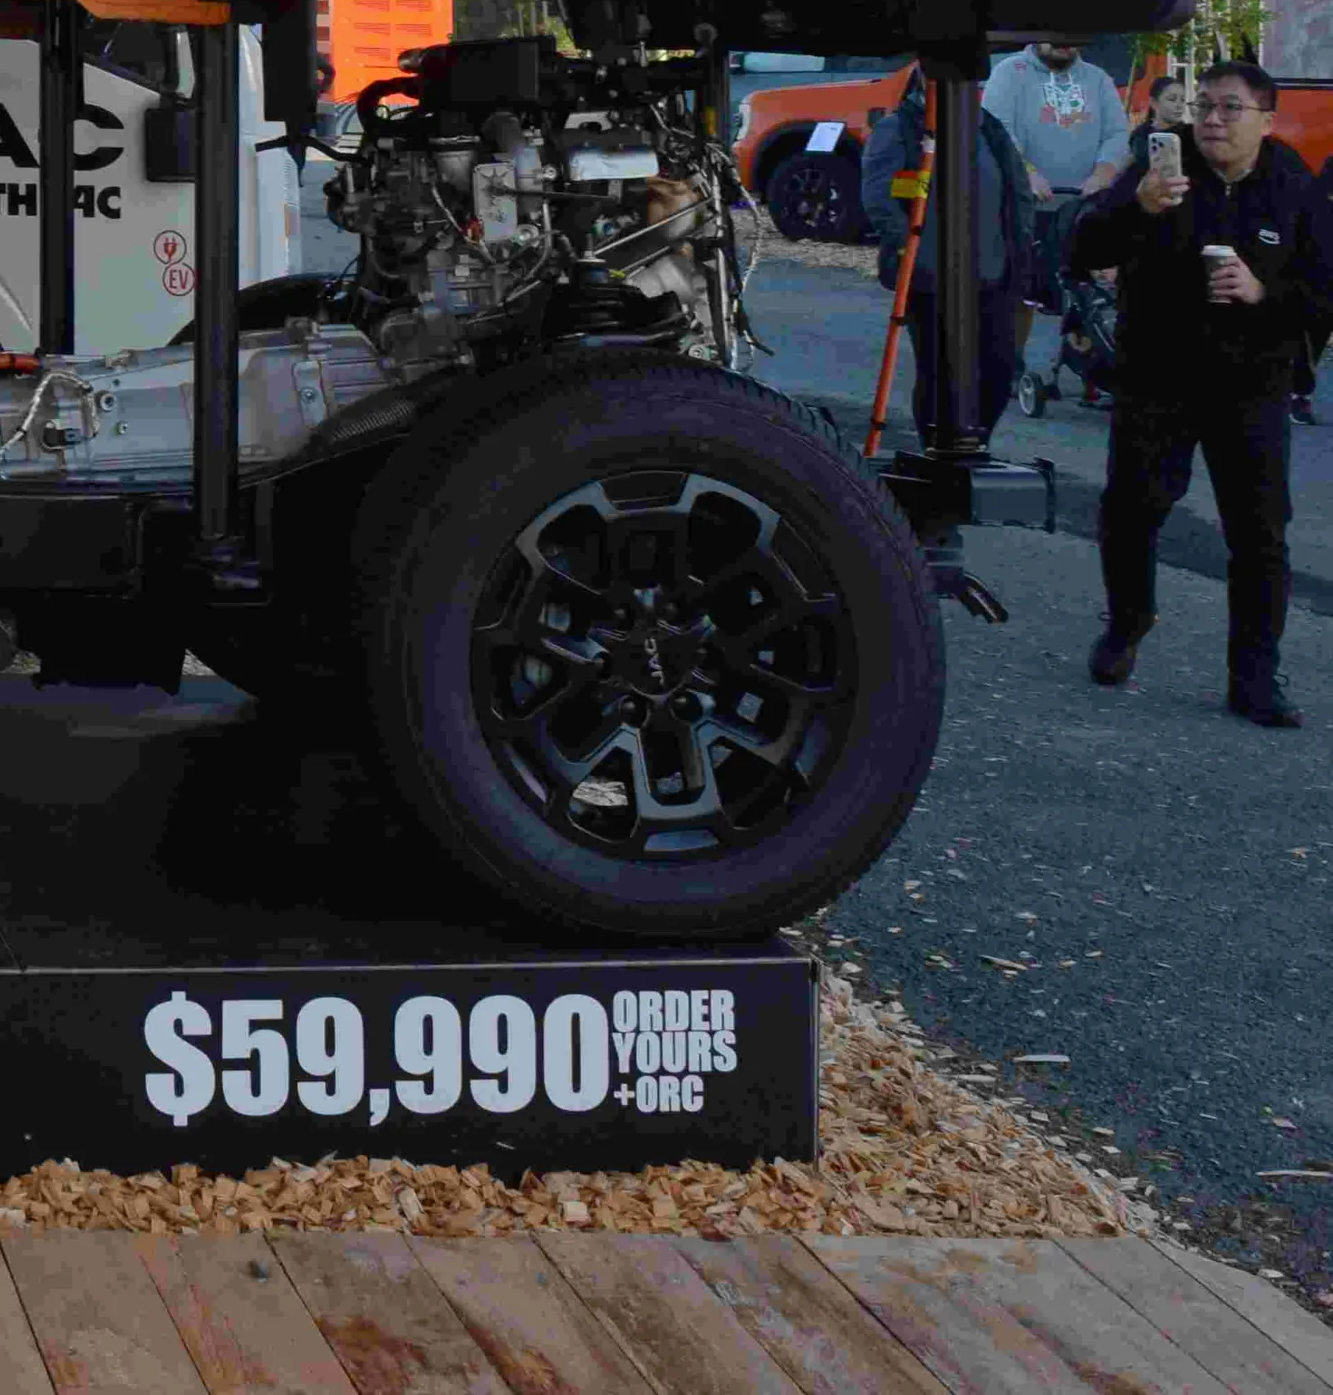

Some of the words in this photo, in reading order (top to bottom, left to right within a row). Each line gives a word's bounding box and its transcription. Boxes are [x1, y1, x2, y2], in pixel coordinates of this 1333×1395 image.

[169, 269, 189, 290] EV
[611, 989, 736, 1033] ORDER
[143, 990, 610, 1127] $59,990
[611, 1030, 738, 1074] YOURS
[613, 1075, 704, 1114] +ORC
